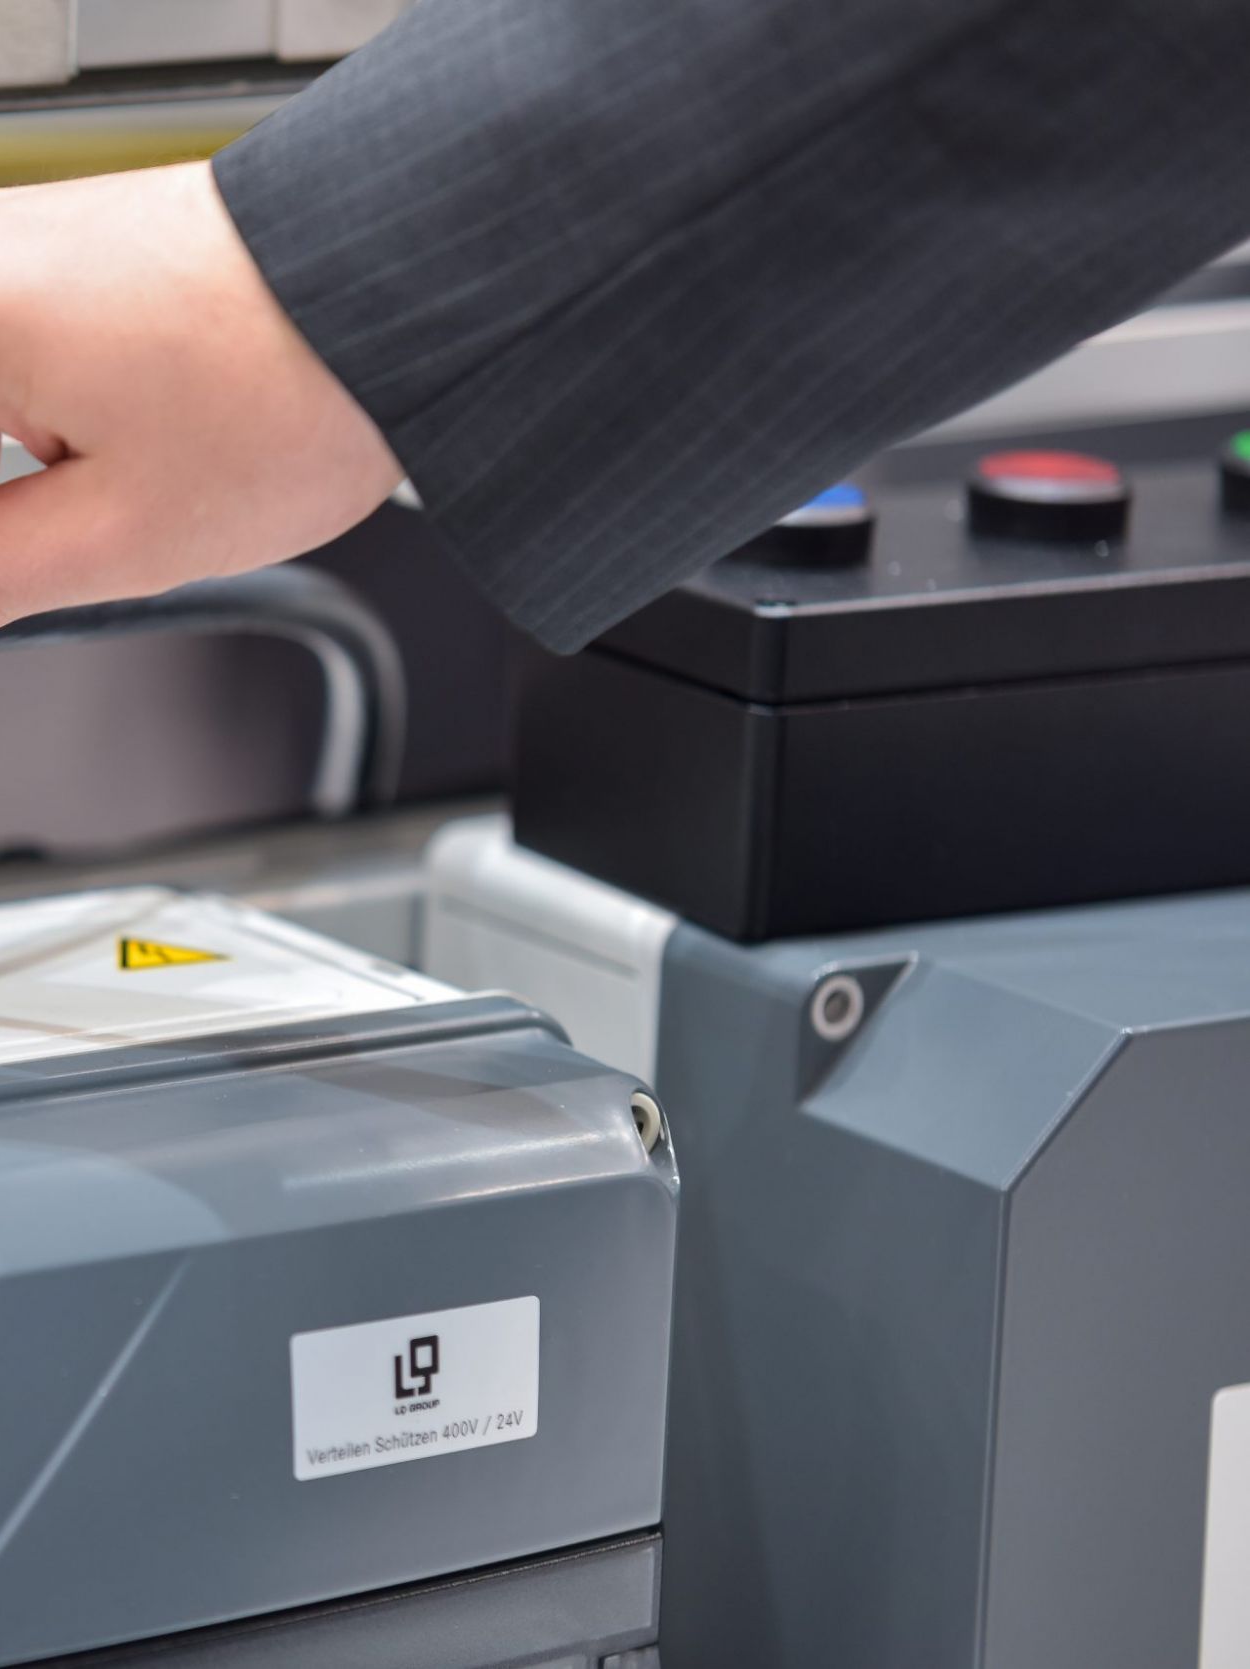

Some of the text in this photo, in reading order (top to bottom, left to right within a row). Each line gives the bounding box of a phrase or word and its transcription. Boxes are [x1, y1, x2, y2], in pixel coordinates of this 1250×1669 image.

[410, 1399, 441, 1412] GROUP
[307, 1410, 524, 1466] Verteilen Schützen 400V / 24V
